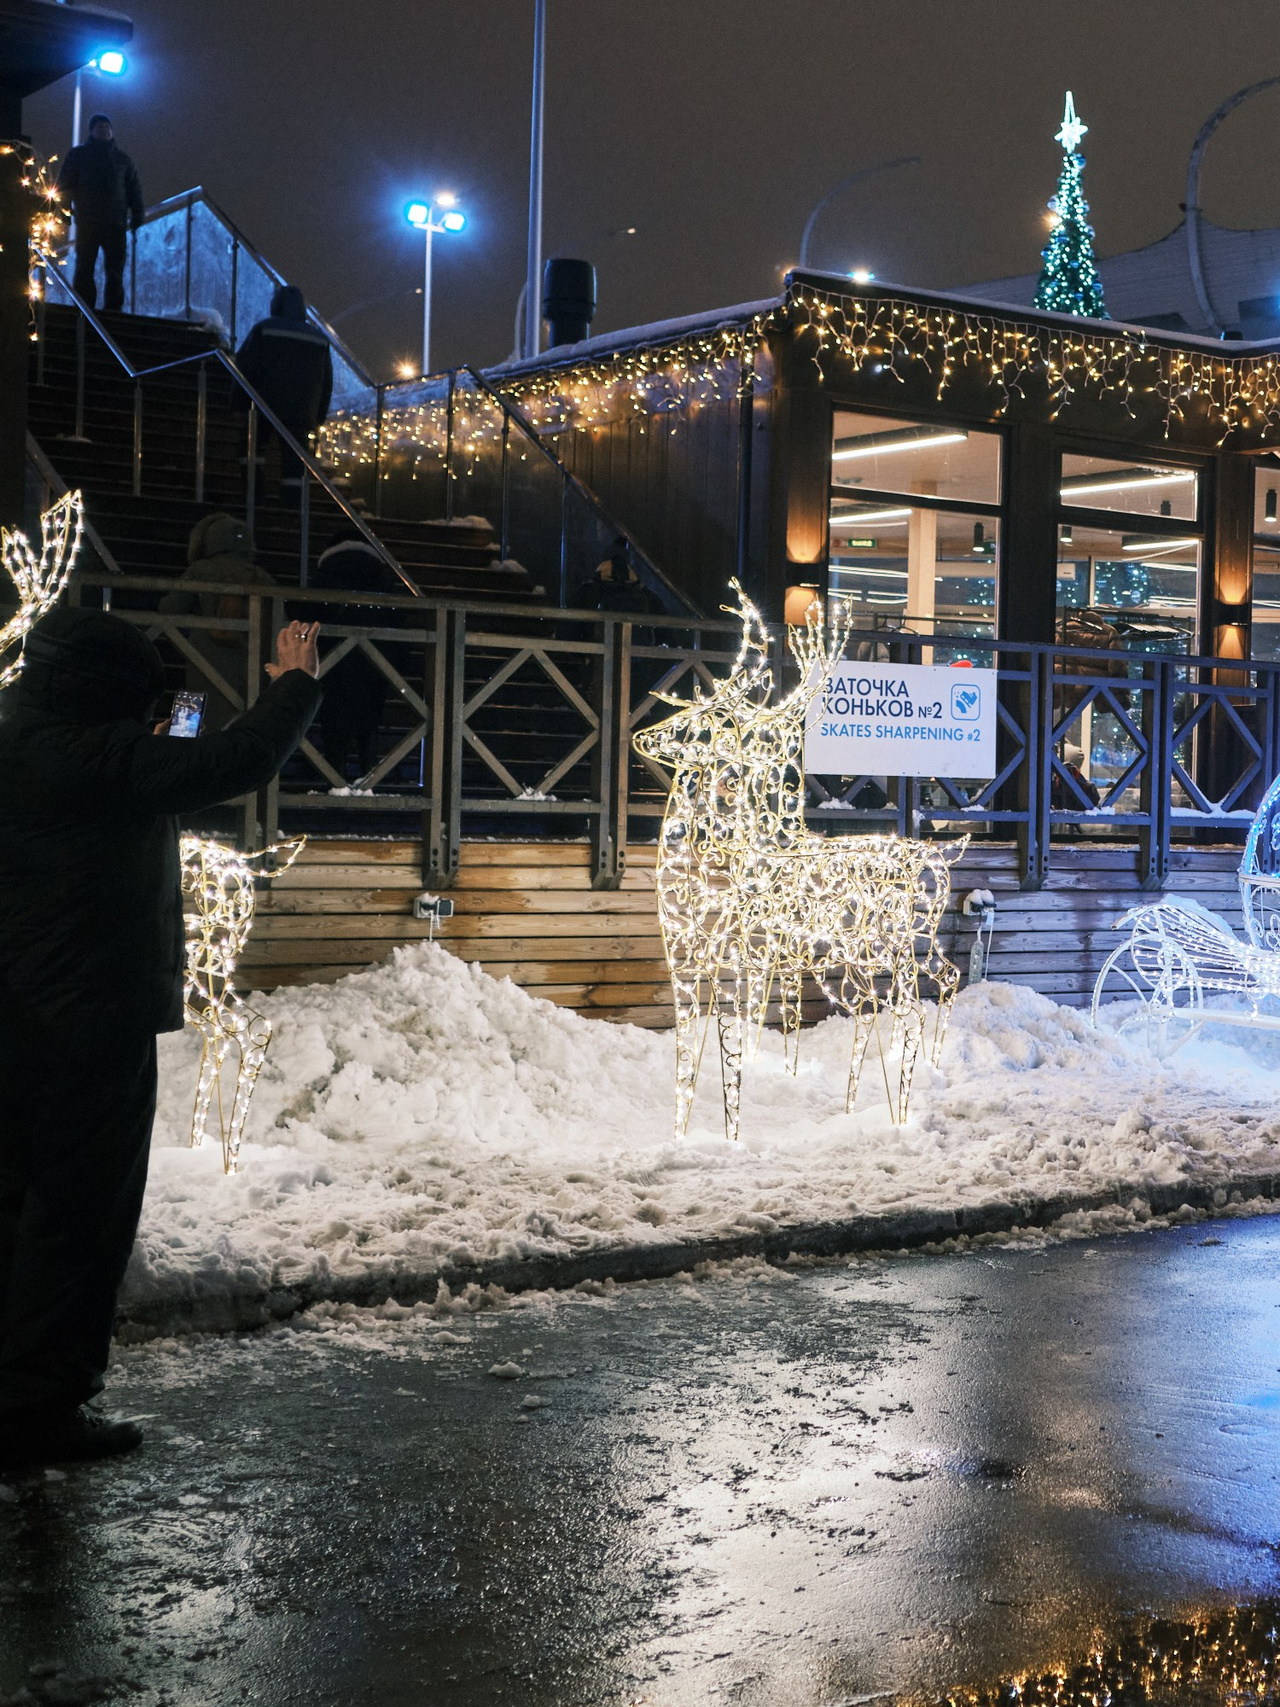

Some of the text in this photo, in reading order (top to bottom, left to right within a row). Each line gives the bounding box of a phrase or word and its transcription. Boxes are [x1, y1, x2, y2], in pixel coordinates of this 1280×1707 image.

[825, 677, 909, 698] ЗАТОЧКА
[822, 697, 943, 719] КОНЬКОВ №2
[820, 722, 981, 742] SKATES SHARPENING #2
